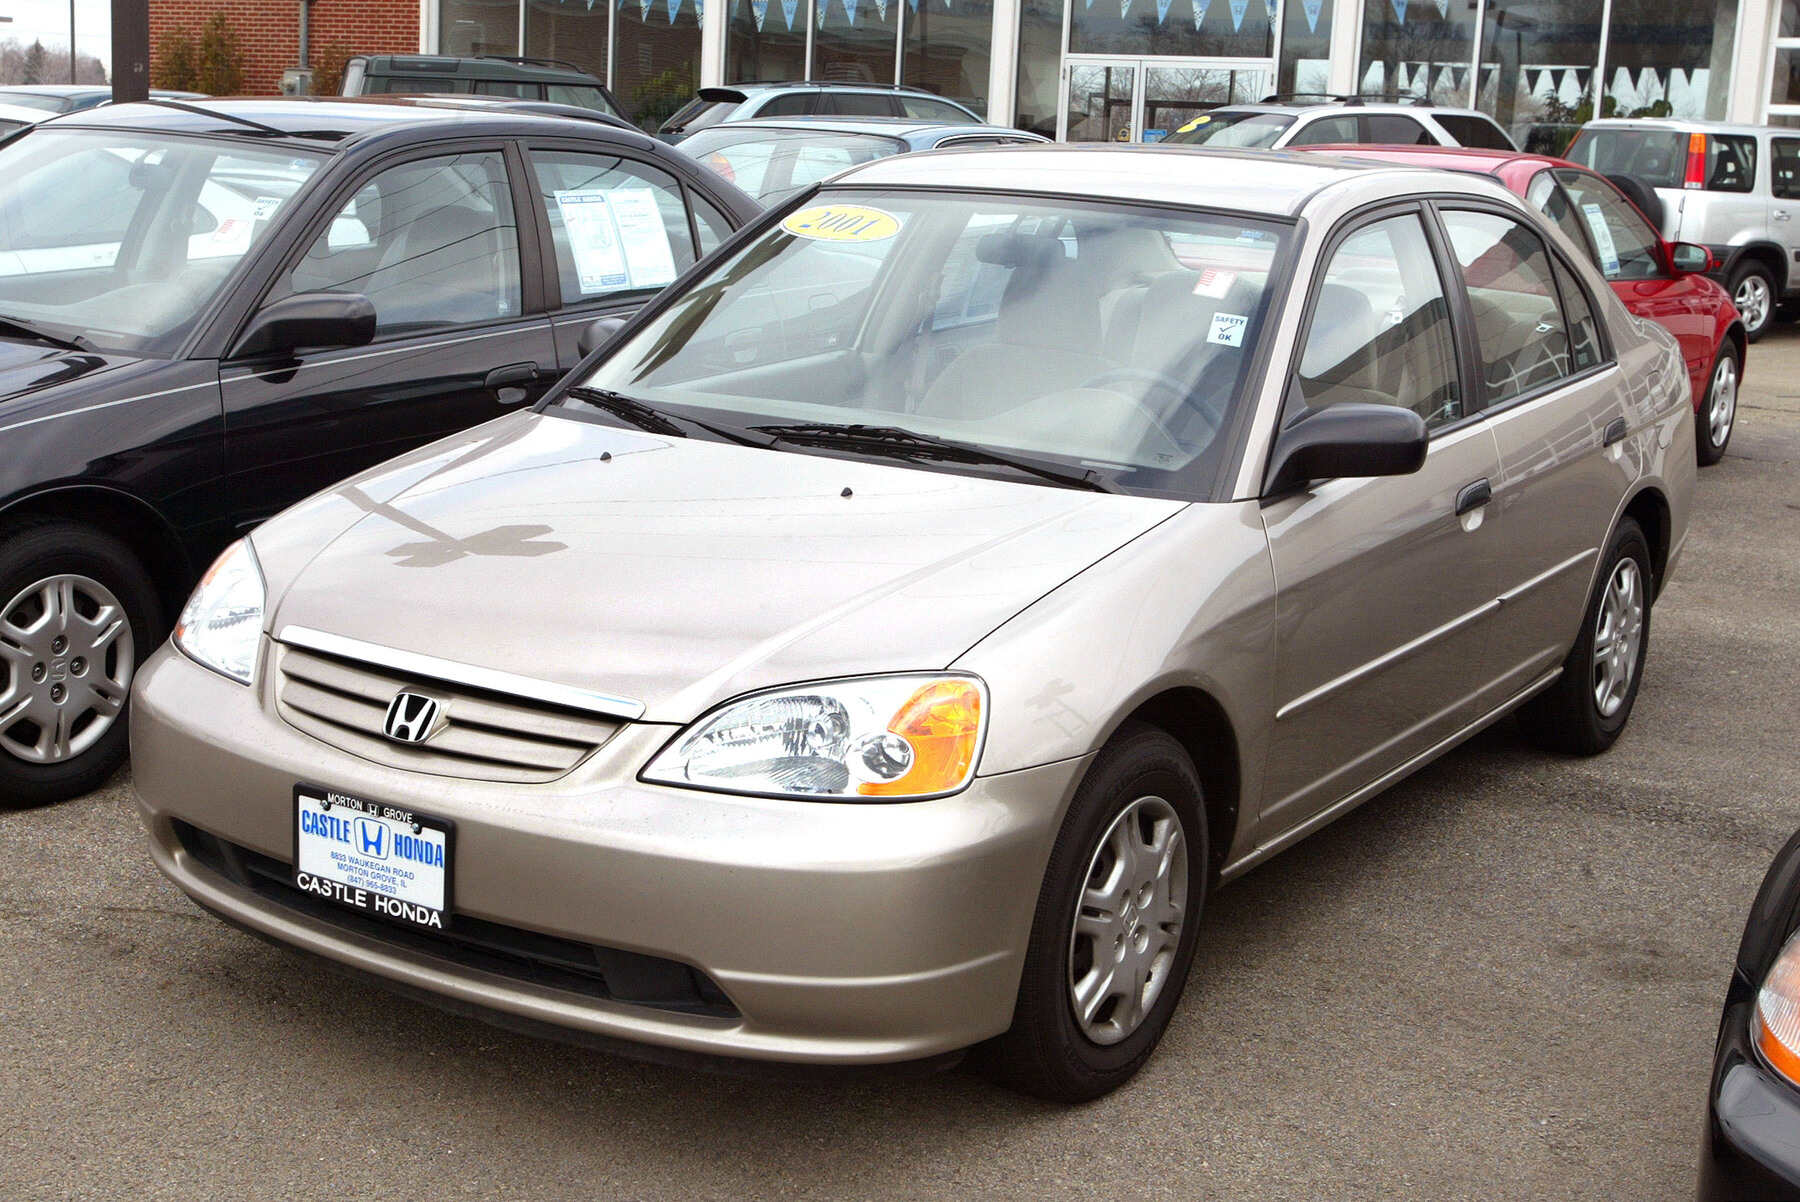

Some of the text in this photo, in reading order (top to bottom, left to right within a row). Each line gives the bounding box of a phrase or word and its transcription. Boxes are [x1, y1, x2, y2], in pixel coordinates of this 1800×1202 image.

[799, 211, 881, 235] 2001
[1215, 316, 1244, 325] SAFETY
[1218, 333, 1232, 341] OK
[327, 793, 363, 811] MORTON
[383, 807, 413, 824] GROVE
[301, 809, 351, 844] CASTLE
[394, 832, 444, 868] HONDA
[337, 861, 369, 878] MORTON
[400, 879, 408, 889] IL
[348, 855, 391, 874] WAUKEGAN
[392, 867, 415, 880] ROAD
[296, 872, 443, 929] CASTLE HONDA
